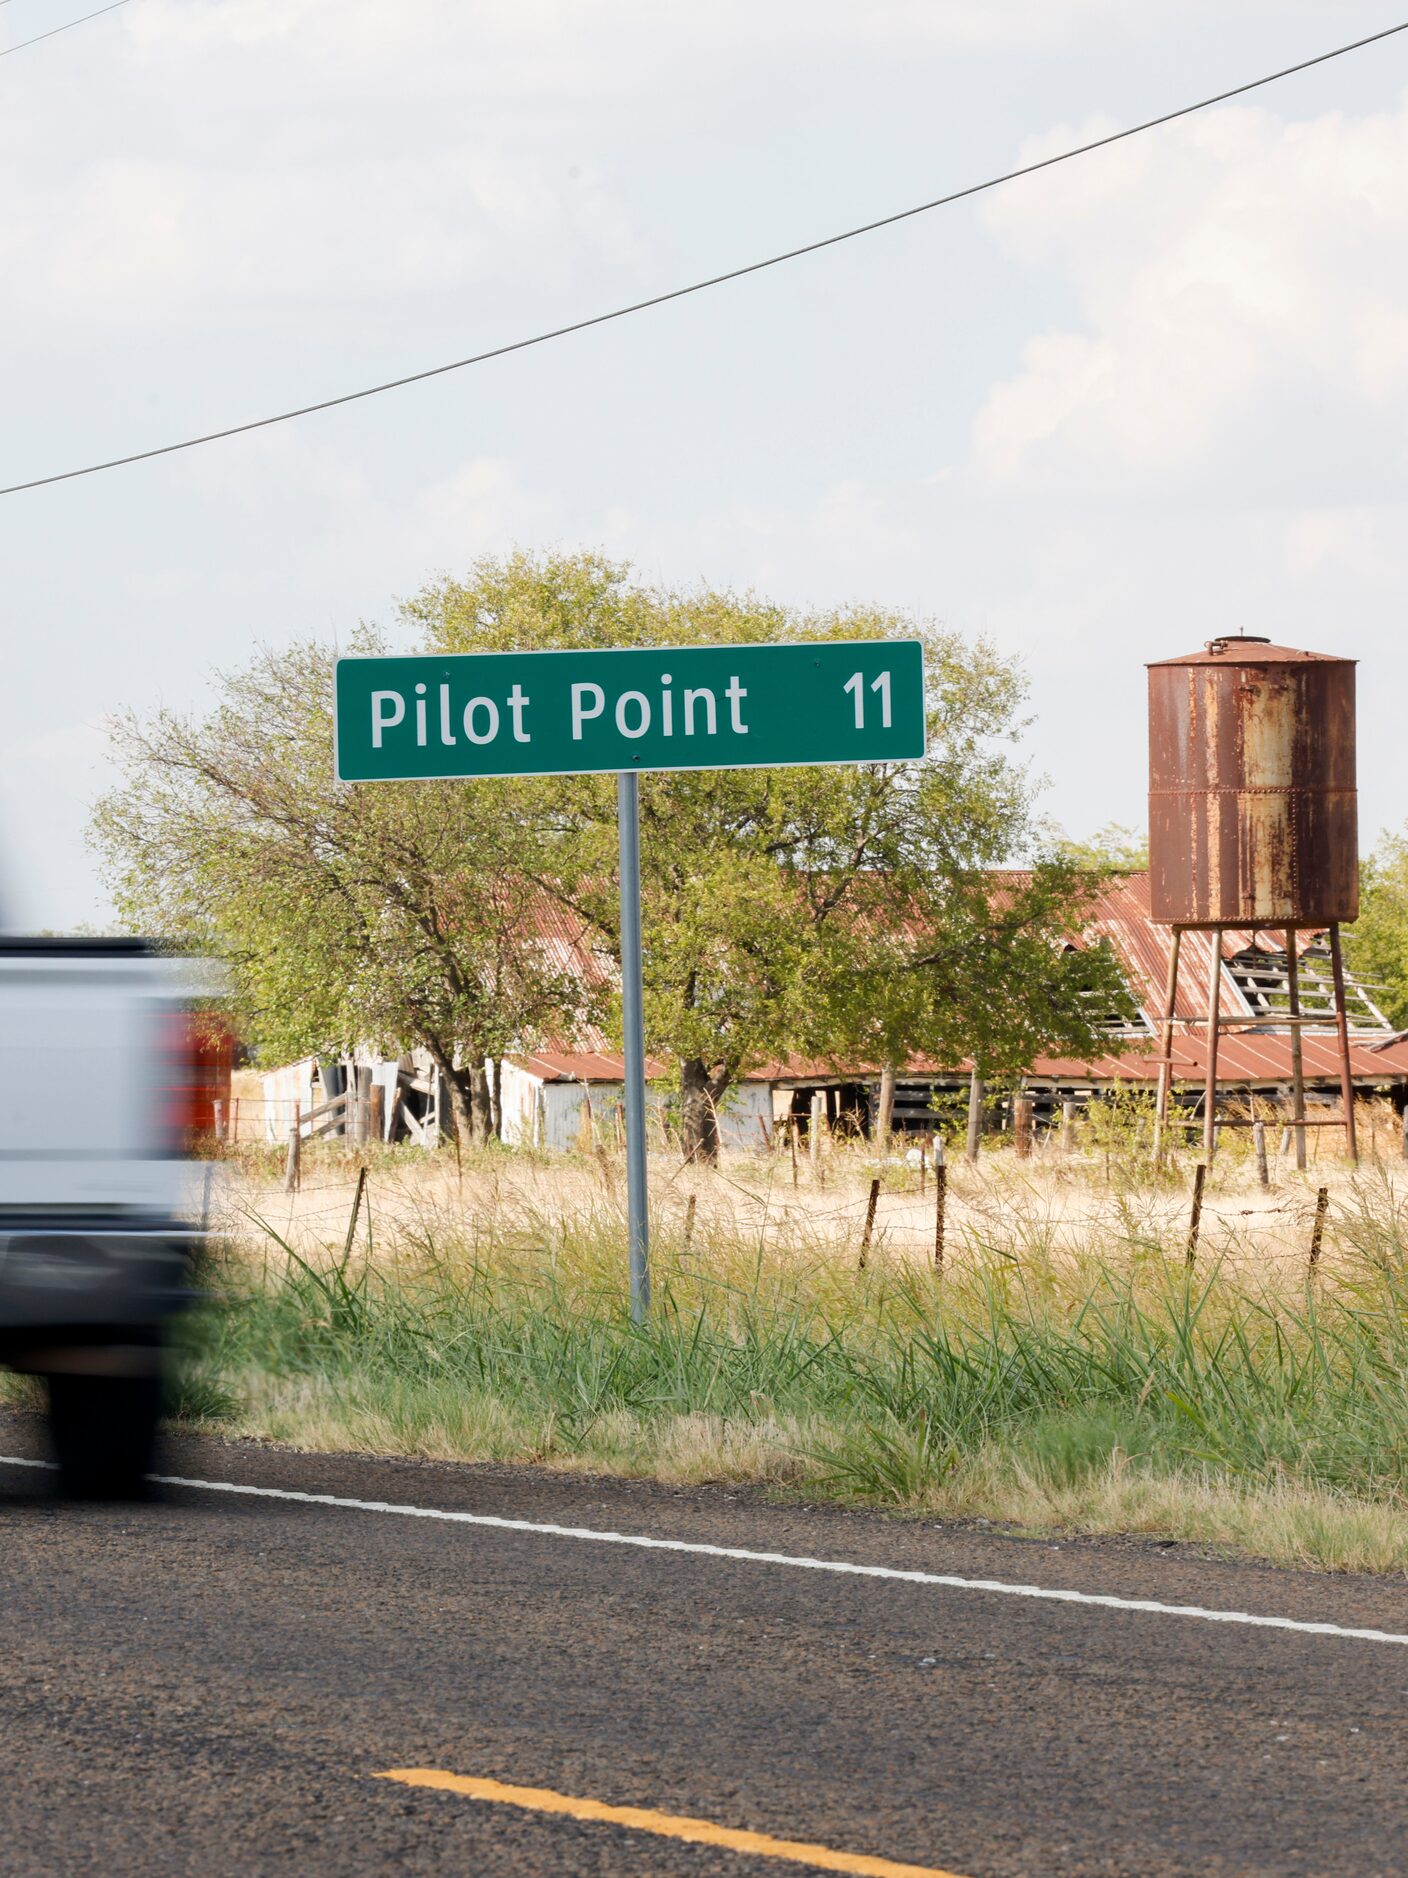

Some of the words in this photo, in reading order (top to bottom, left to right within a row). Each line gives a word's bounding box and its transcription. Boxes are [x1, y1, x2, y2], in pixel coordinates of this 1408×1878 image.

[371, 682, 531, 748] Pilot
[571, 673, 749, 740] Point
[843, 671, 892, 729] 11
